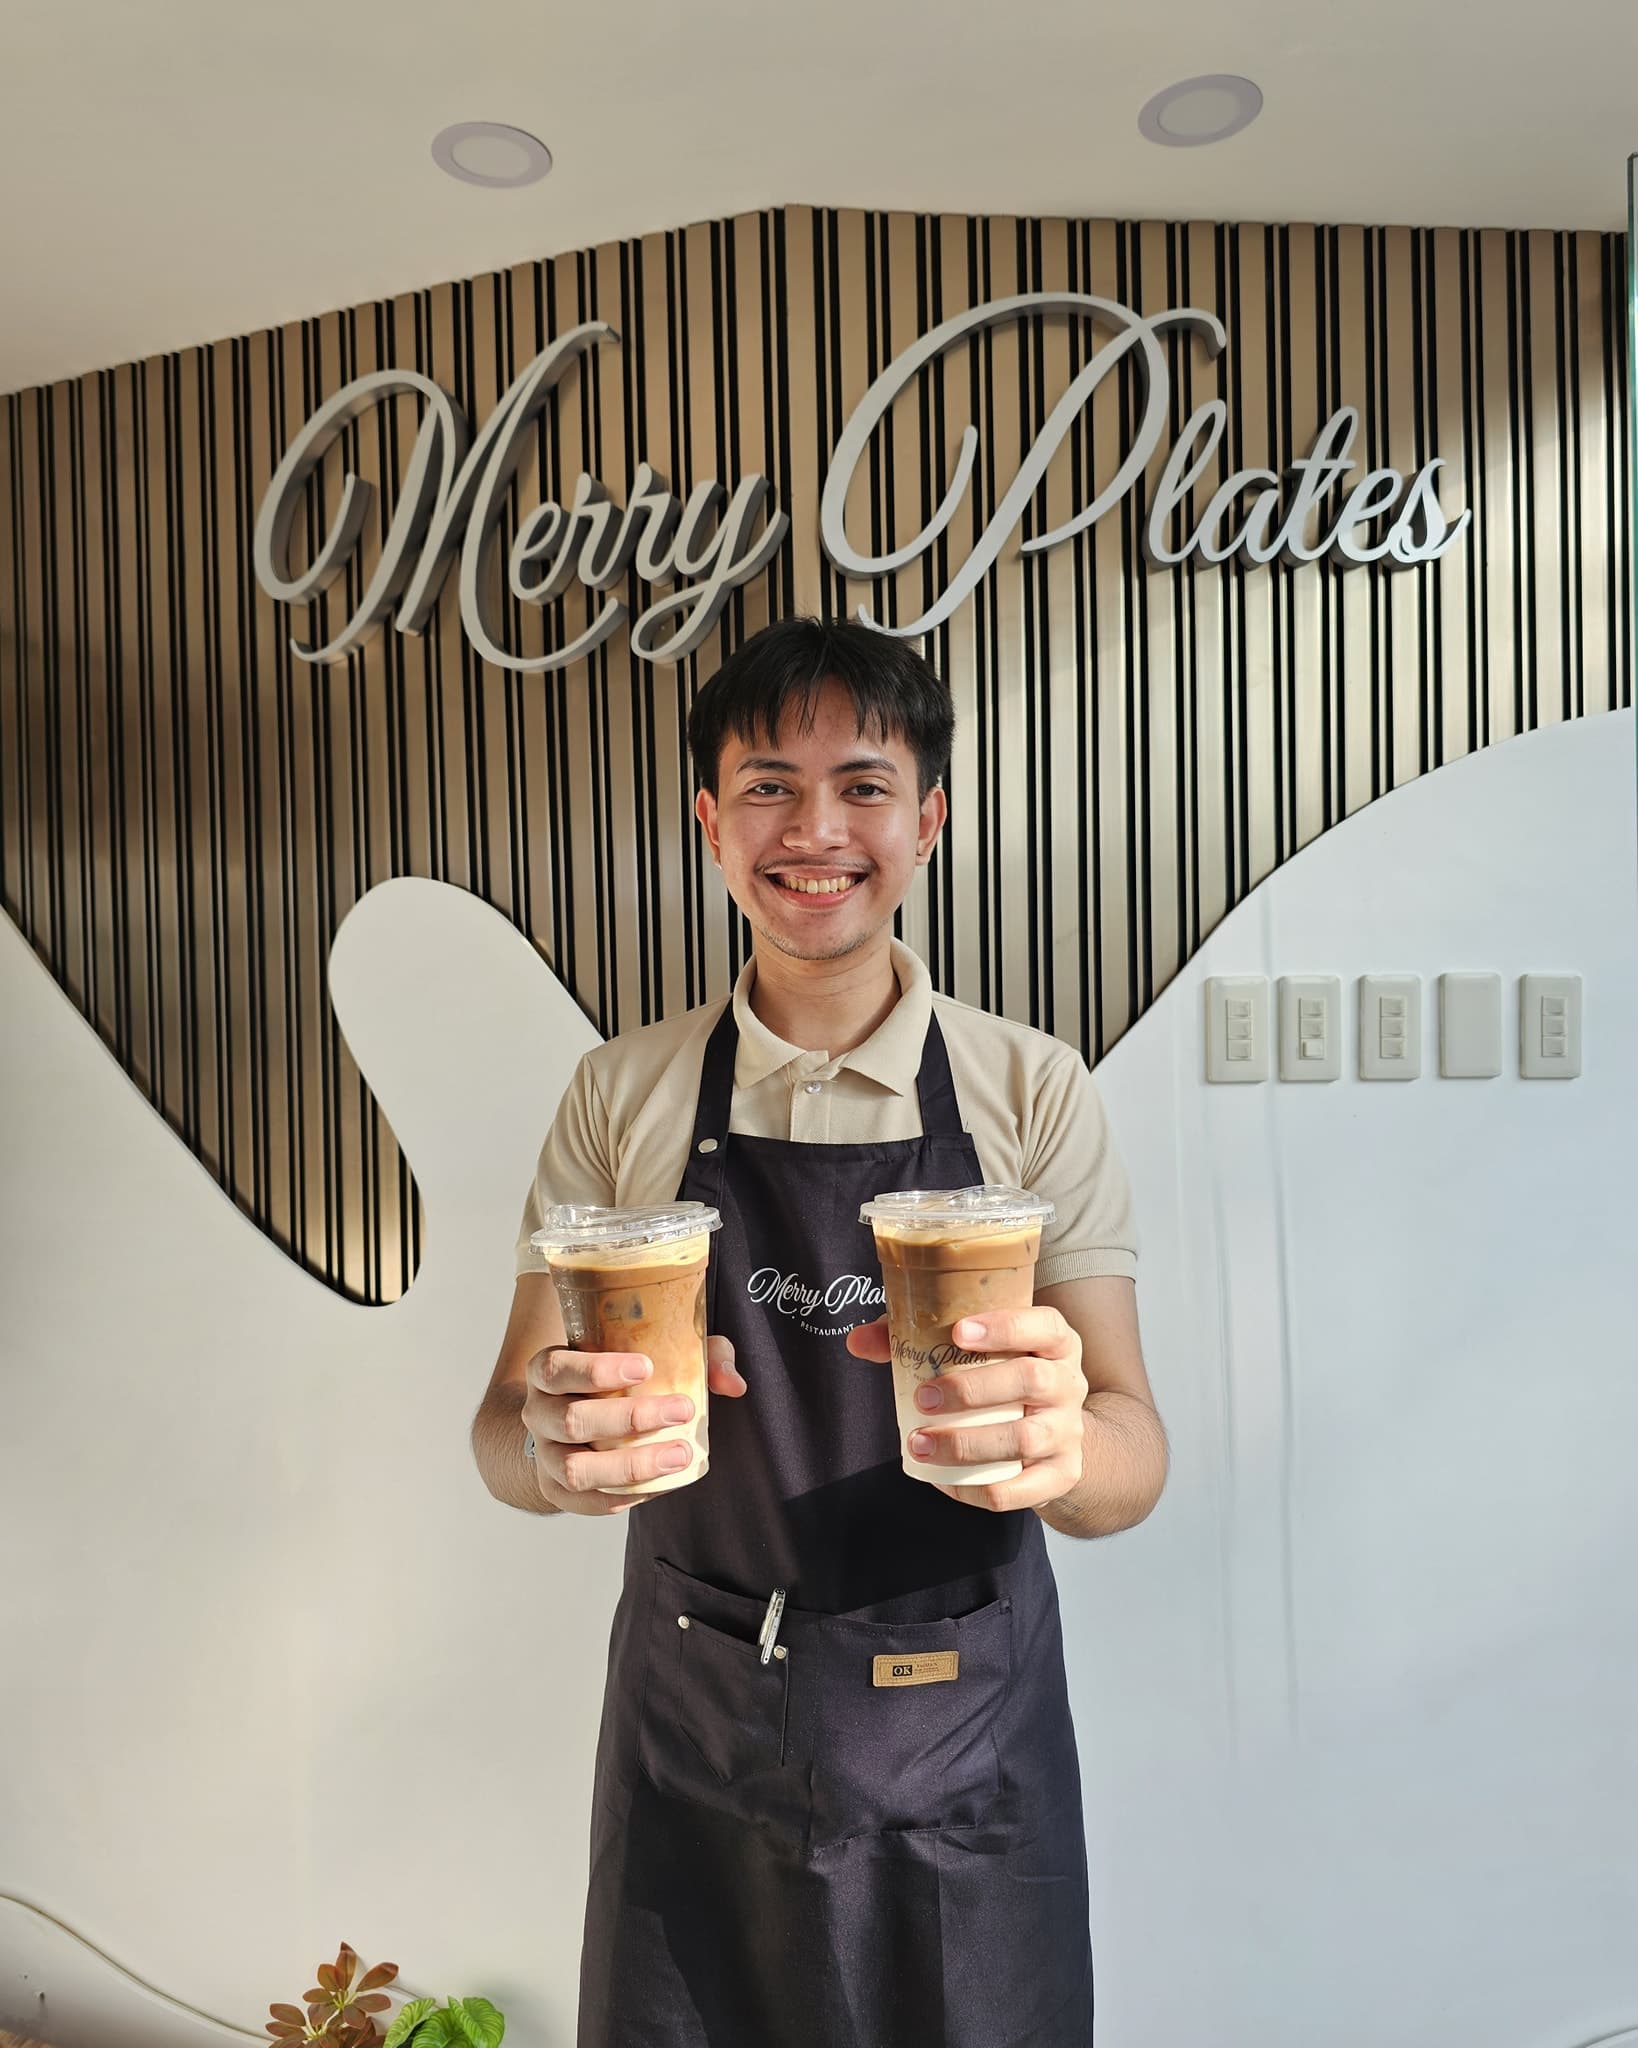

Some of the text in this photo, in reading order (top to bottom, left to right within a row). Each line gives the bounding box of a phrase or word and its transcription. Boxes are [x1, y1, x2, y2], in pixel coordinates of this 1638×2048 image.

[254, 292, 1471, 674] Merry Plates
[747, 1267, 823, 1316] Merry
[800, 1321, 855, 1336] RESTAURANT
[890, 1334, 927, 1370] Merry
[893, 1666, 911, 1676] OK
